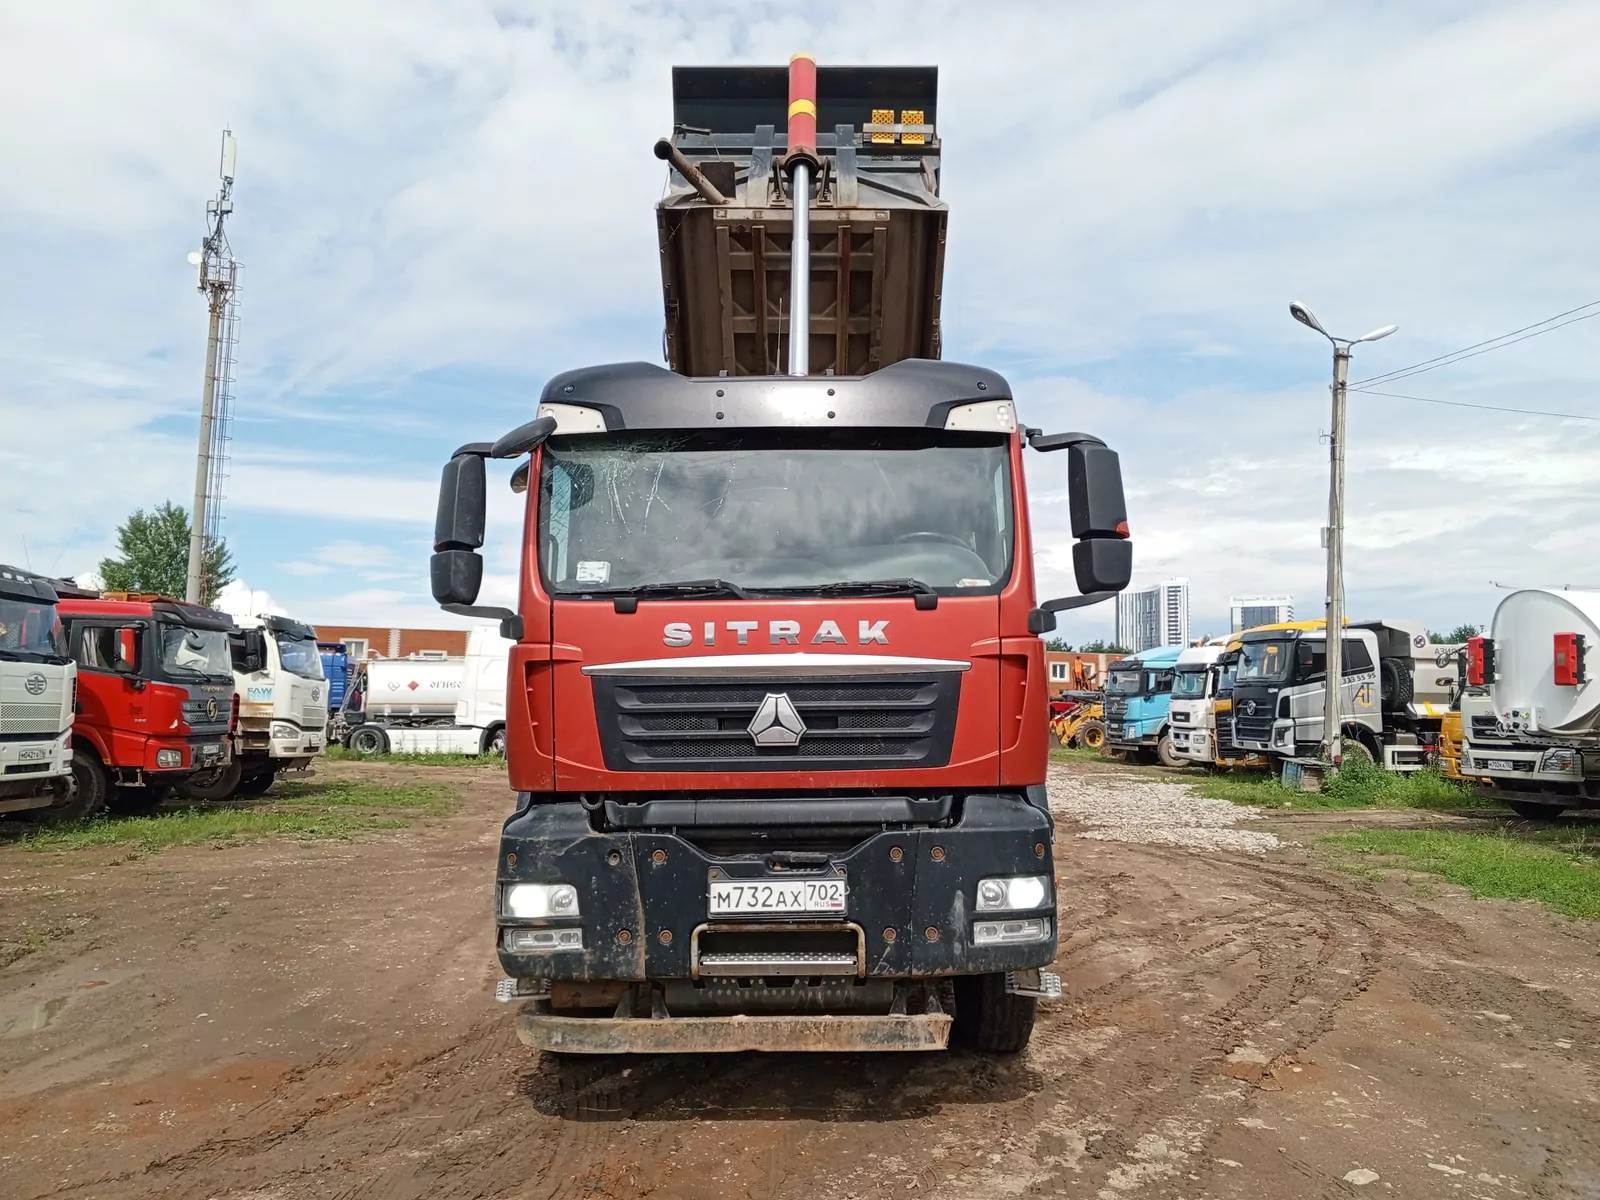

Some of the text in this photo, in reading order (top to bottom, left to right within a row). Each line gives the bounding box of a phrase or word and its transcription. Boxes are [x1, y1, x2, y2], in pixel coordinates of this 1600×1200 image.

[663, 620, 890, 647] SITRAK
[1356, 674, 1366, 682] 55
[1367, 672, 1377, 680] 95
[717, 884, 840, 909] М732АХ 702
